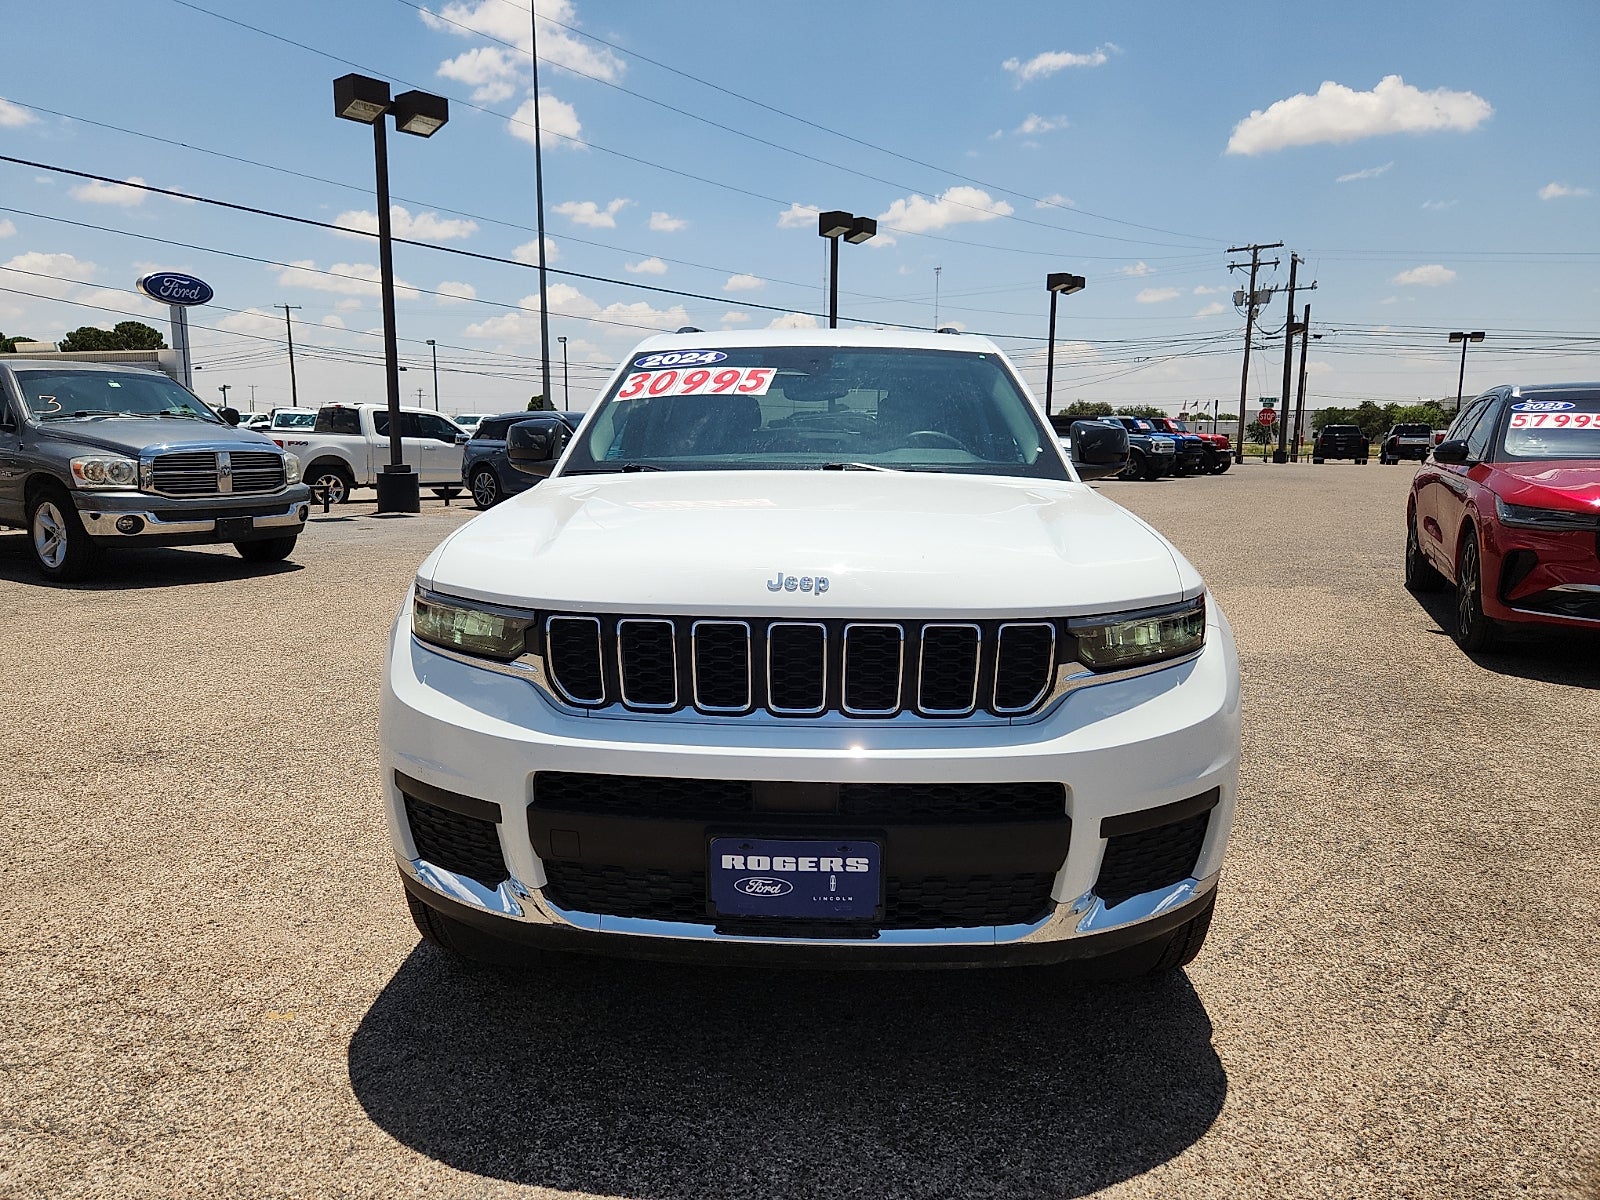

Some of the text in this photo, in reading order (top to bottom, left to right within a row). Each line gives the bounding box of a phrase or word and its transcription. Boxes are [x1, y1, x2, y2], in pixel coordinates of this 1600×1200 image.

[160, 277, 201, 299] Ford
[643, 352, 717, 367] 2024
[619, 370, 772, 398] 30995
[33, 394, 62, 414] 3
[1259, 412, 1276, 420] STOP
[766, 572, 830, 596] Jeep
[721, 854, 869, 873] ROGERS
[745, 879, 782, 894] Ford
